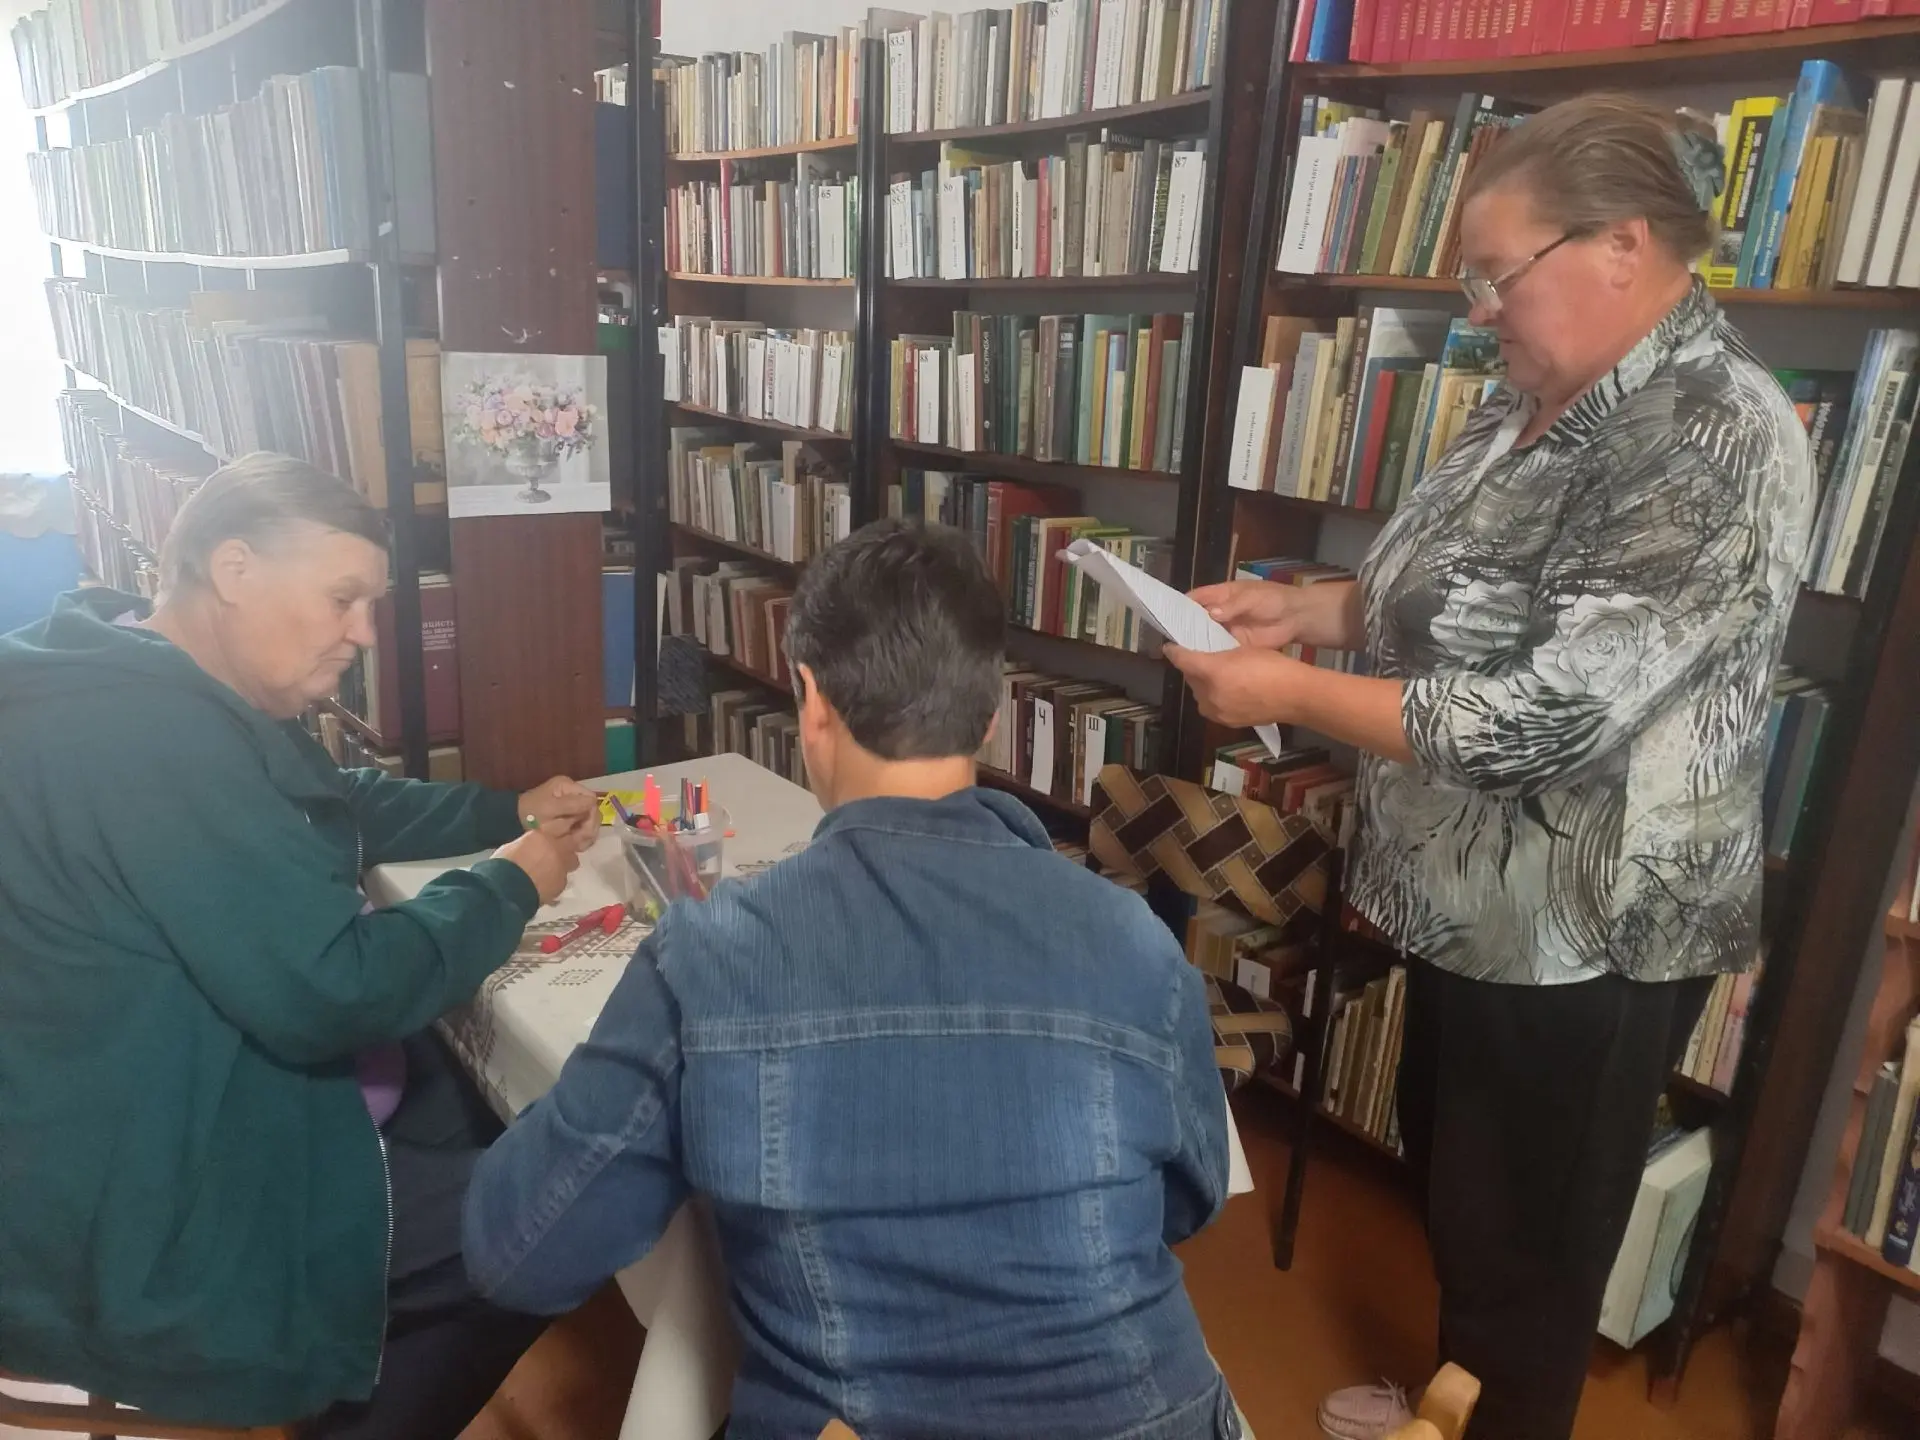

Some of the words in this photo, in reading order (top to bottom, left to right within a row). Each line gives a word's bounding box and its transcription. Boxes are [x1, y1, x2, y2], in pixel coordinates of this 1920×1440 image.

[1505, 2, 1517, 33] КНИГ
[1640, 0, 1658, 31] КНИГ
[1174, 156, 1187, 168] 87
